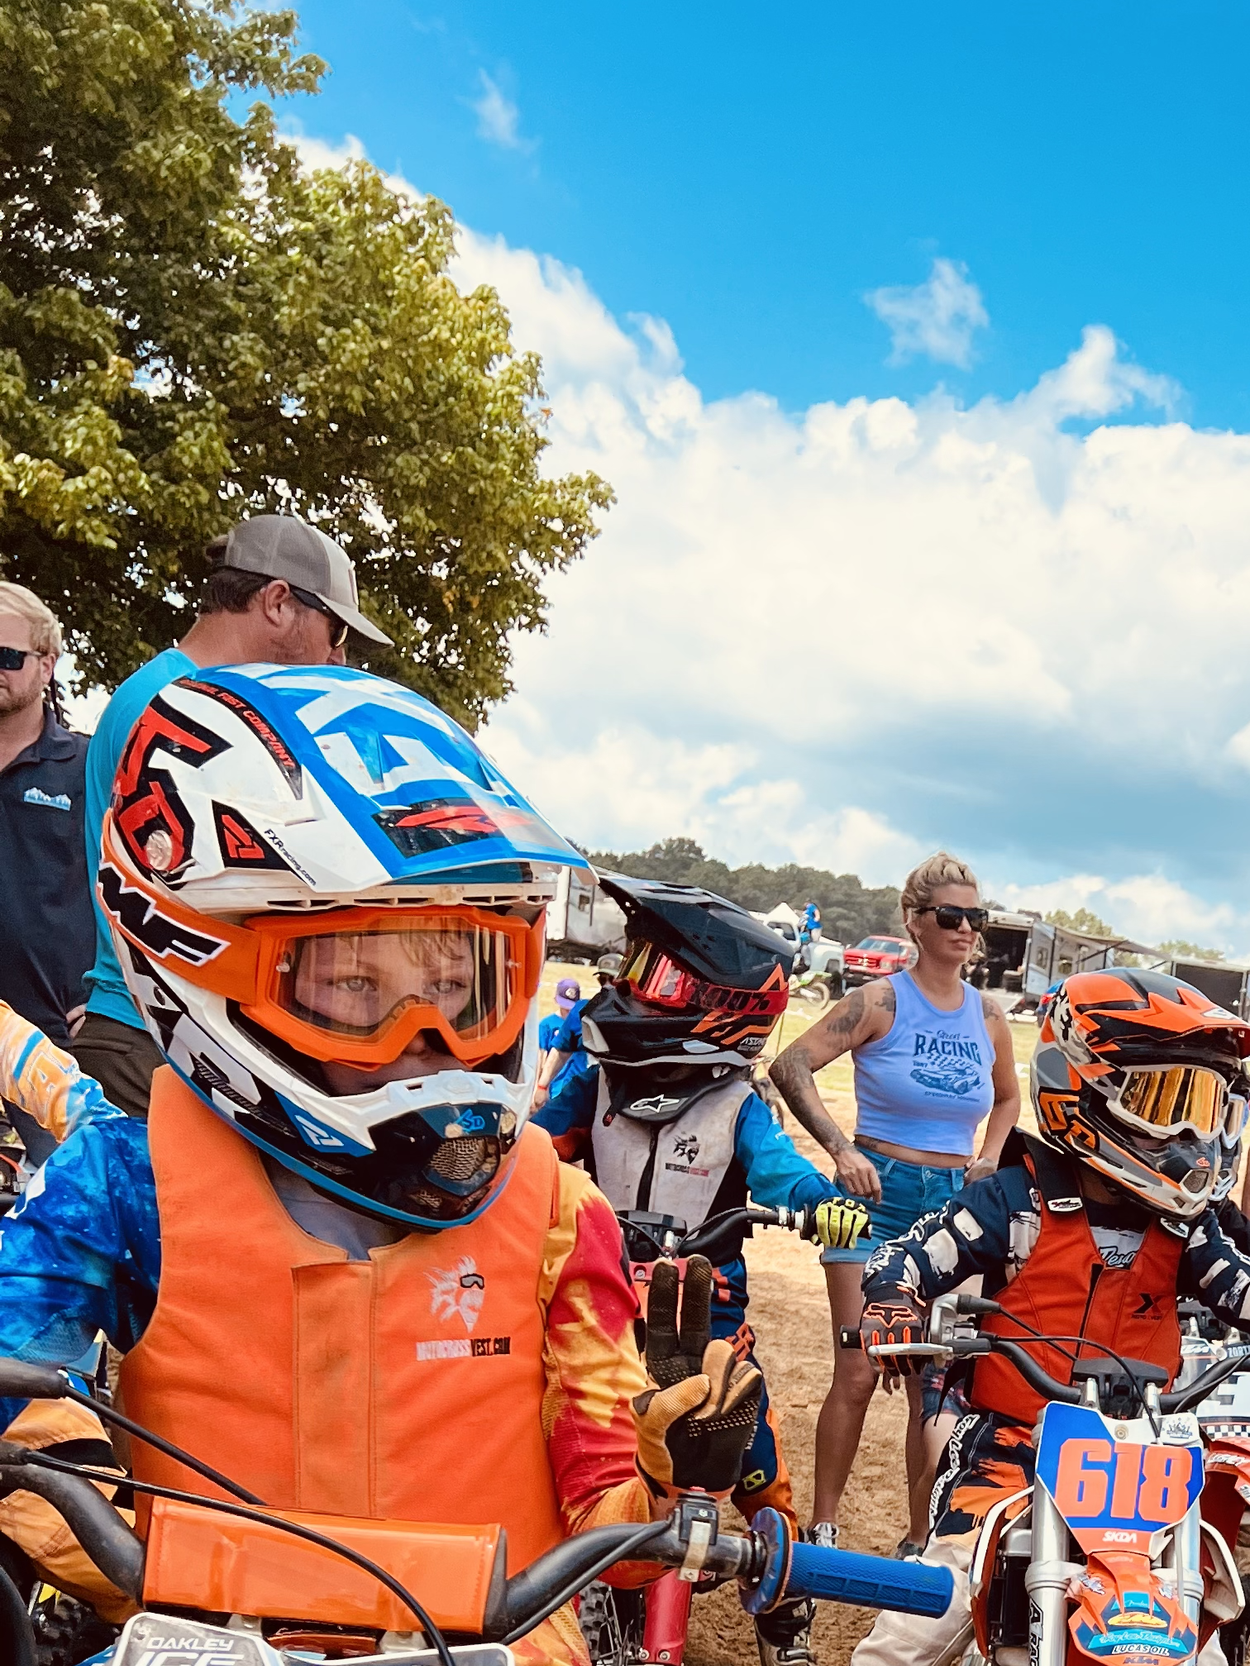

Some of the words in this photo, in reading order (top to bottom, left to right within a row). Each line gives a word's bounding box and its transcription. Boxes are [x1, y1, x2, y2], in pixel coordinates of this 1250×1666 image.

[913, 1032, 983, 1067] RACING
[1054, 1438, 1193, 1521] 618
[1102, 1531, 1138, 1544] SKDA
[147, 1634, 235, 1653] OAKLEY
[1111, 1645, 1150, 1655] LUCAS
